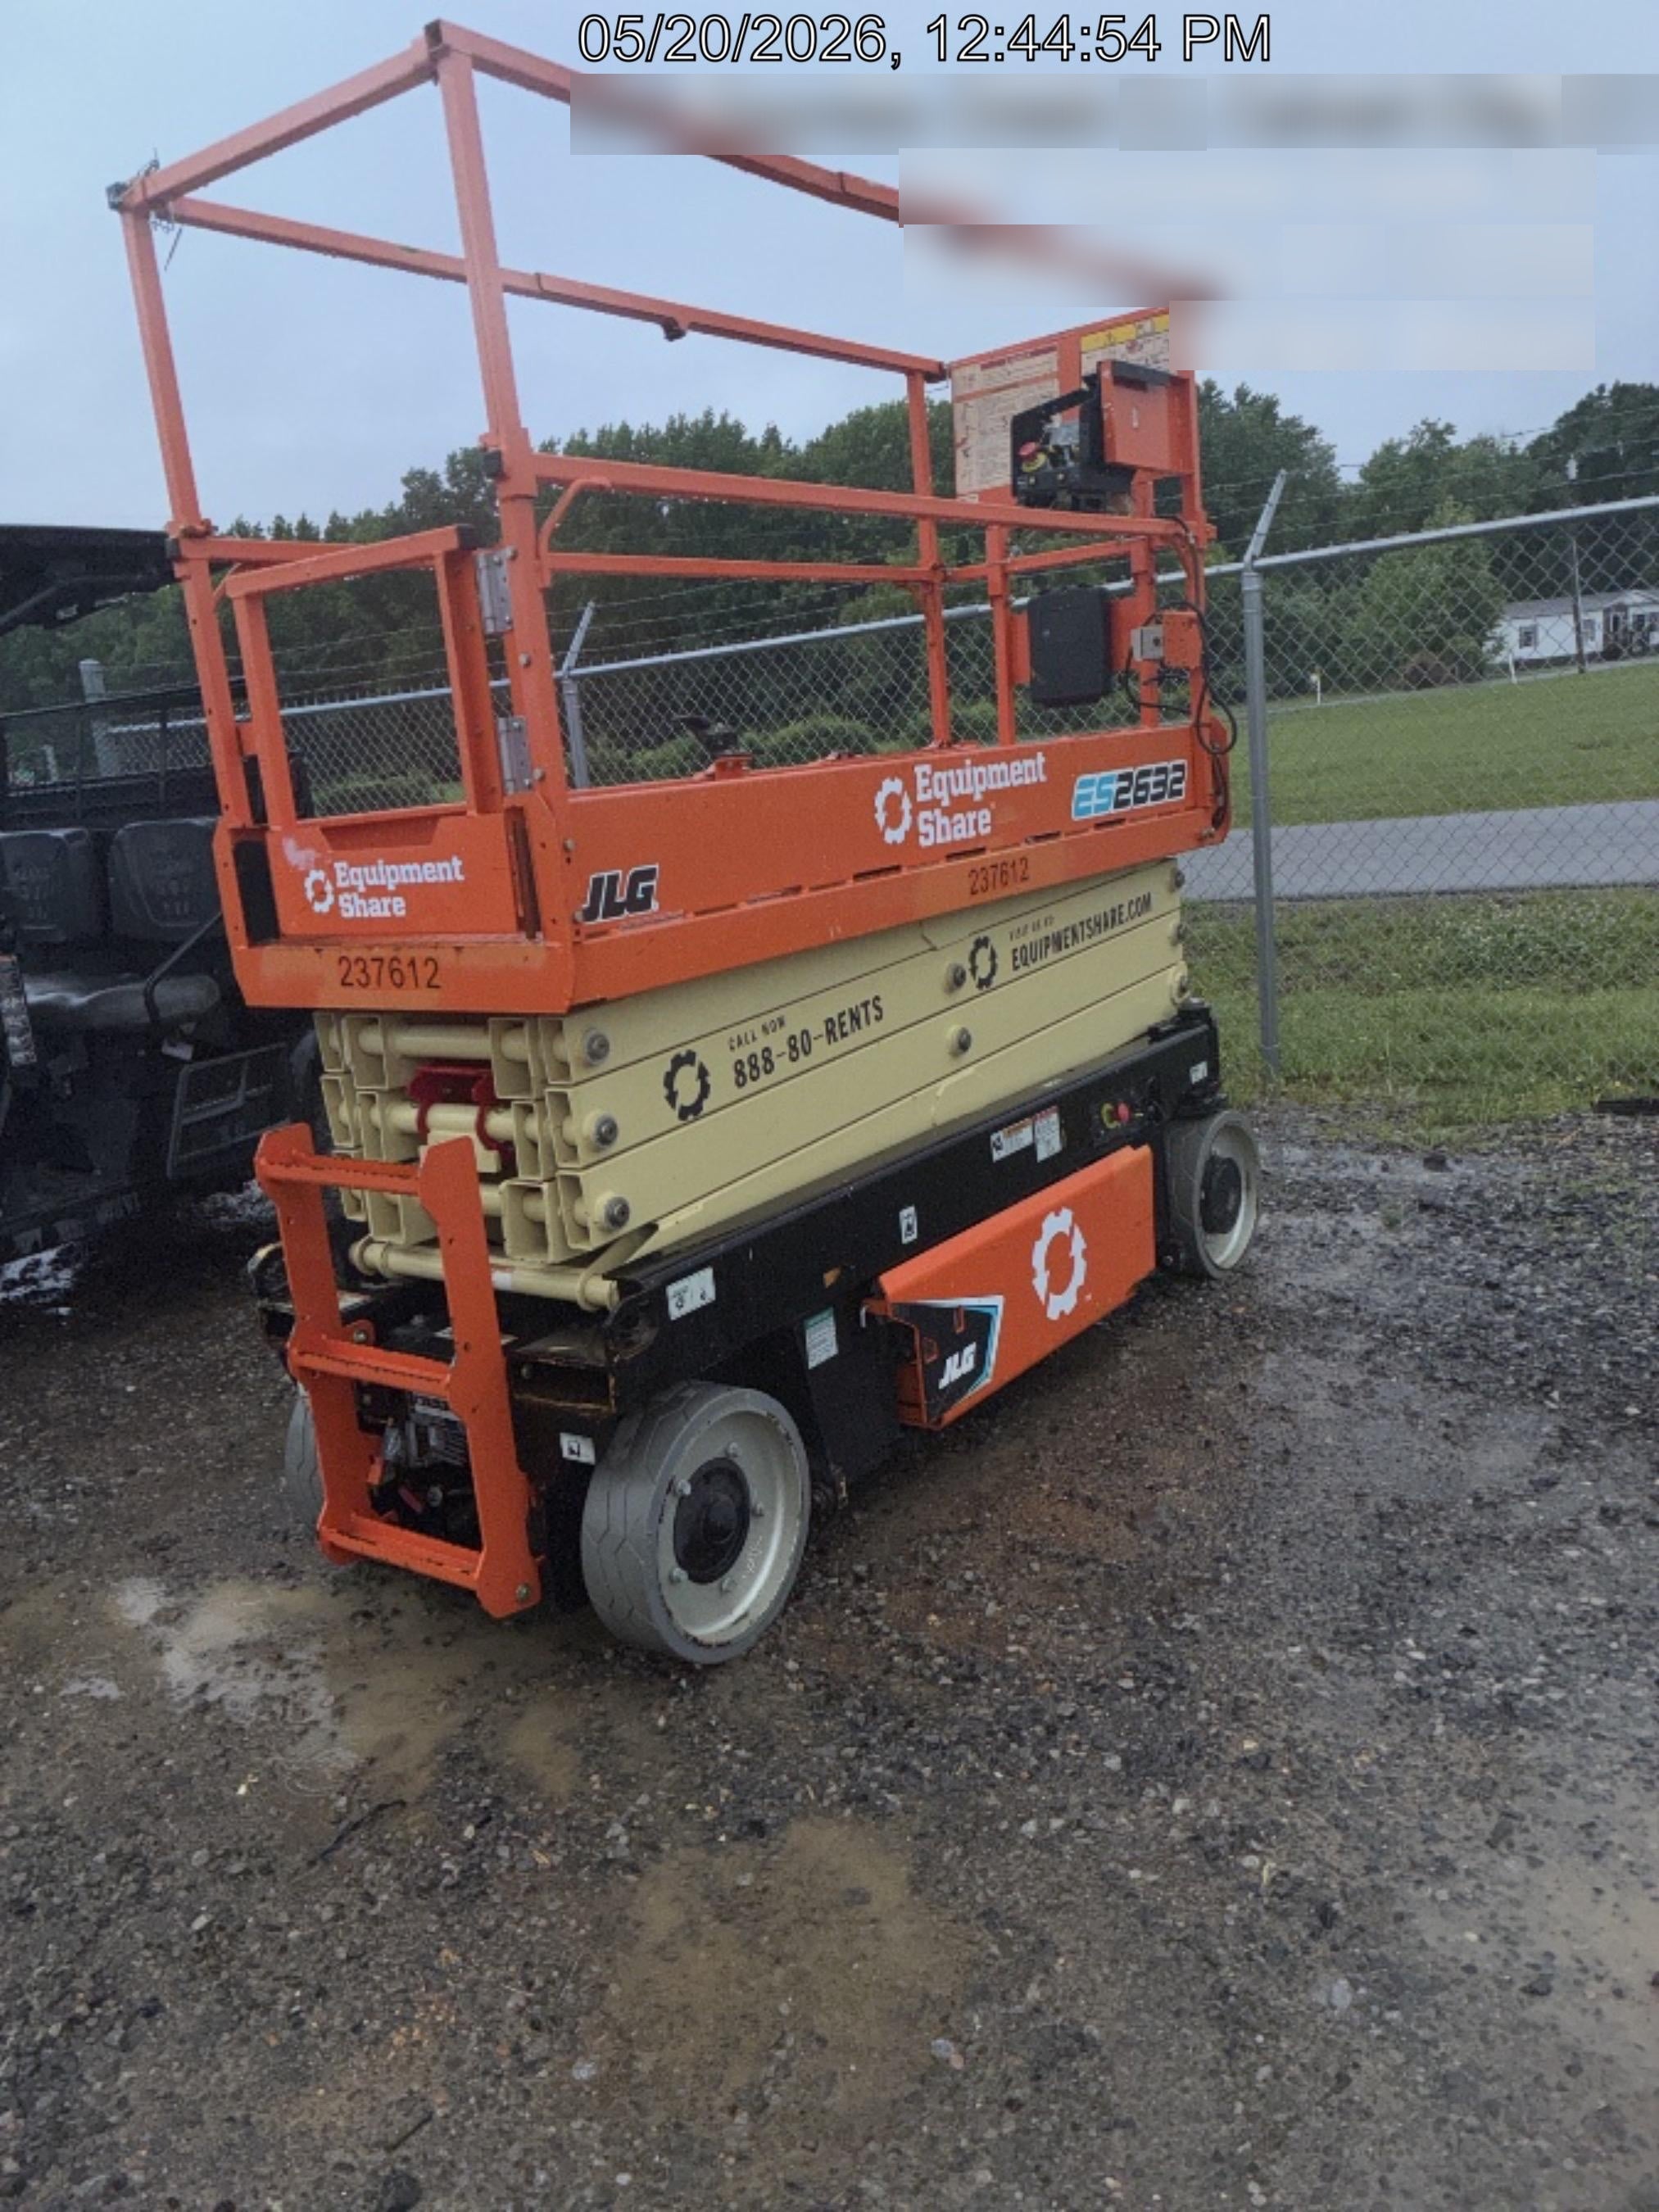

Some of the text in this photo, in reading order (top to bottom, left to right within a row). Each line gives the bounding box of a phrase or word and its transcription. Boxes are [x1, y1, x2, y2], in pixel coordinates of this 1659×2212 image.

[914, 751, 1047, 807] Equipment
[1072, 759, 1188, 821] ES2632
[918, 808, 991, 847] Share
[333, 855, 465, 892] Equipment
[582, 863, 659, 924] JLG
[968, 856, 1029, 895] 237612
[338, 891, 406, 918] Share
[1011, 891, 1152, 971] EQUIPMENTSHARE.COM
[338, 955, 442, 989] 237612
[733, 995, 883, 1088] 888-80-RENTS
[938, 1341, 977, 1389] JLG
